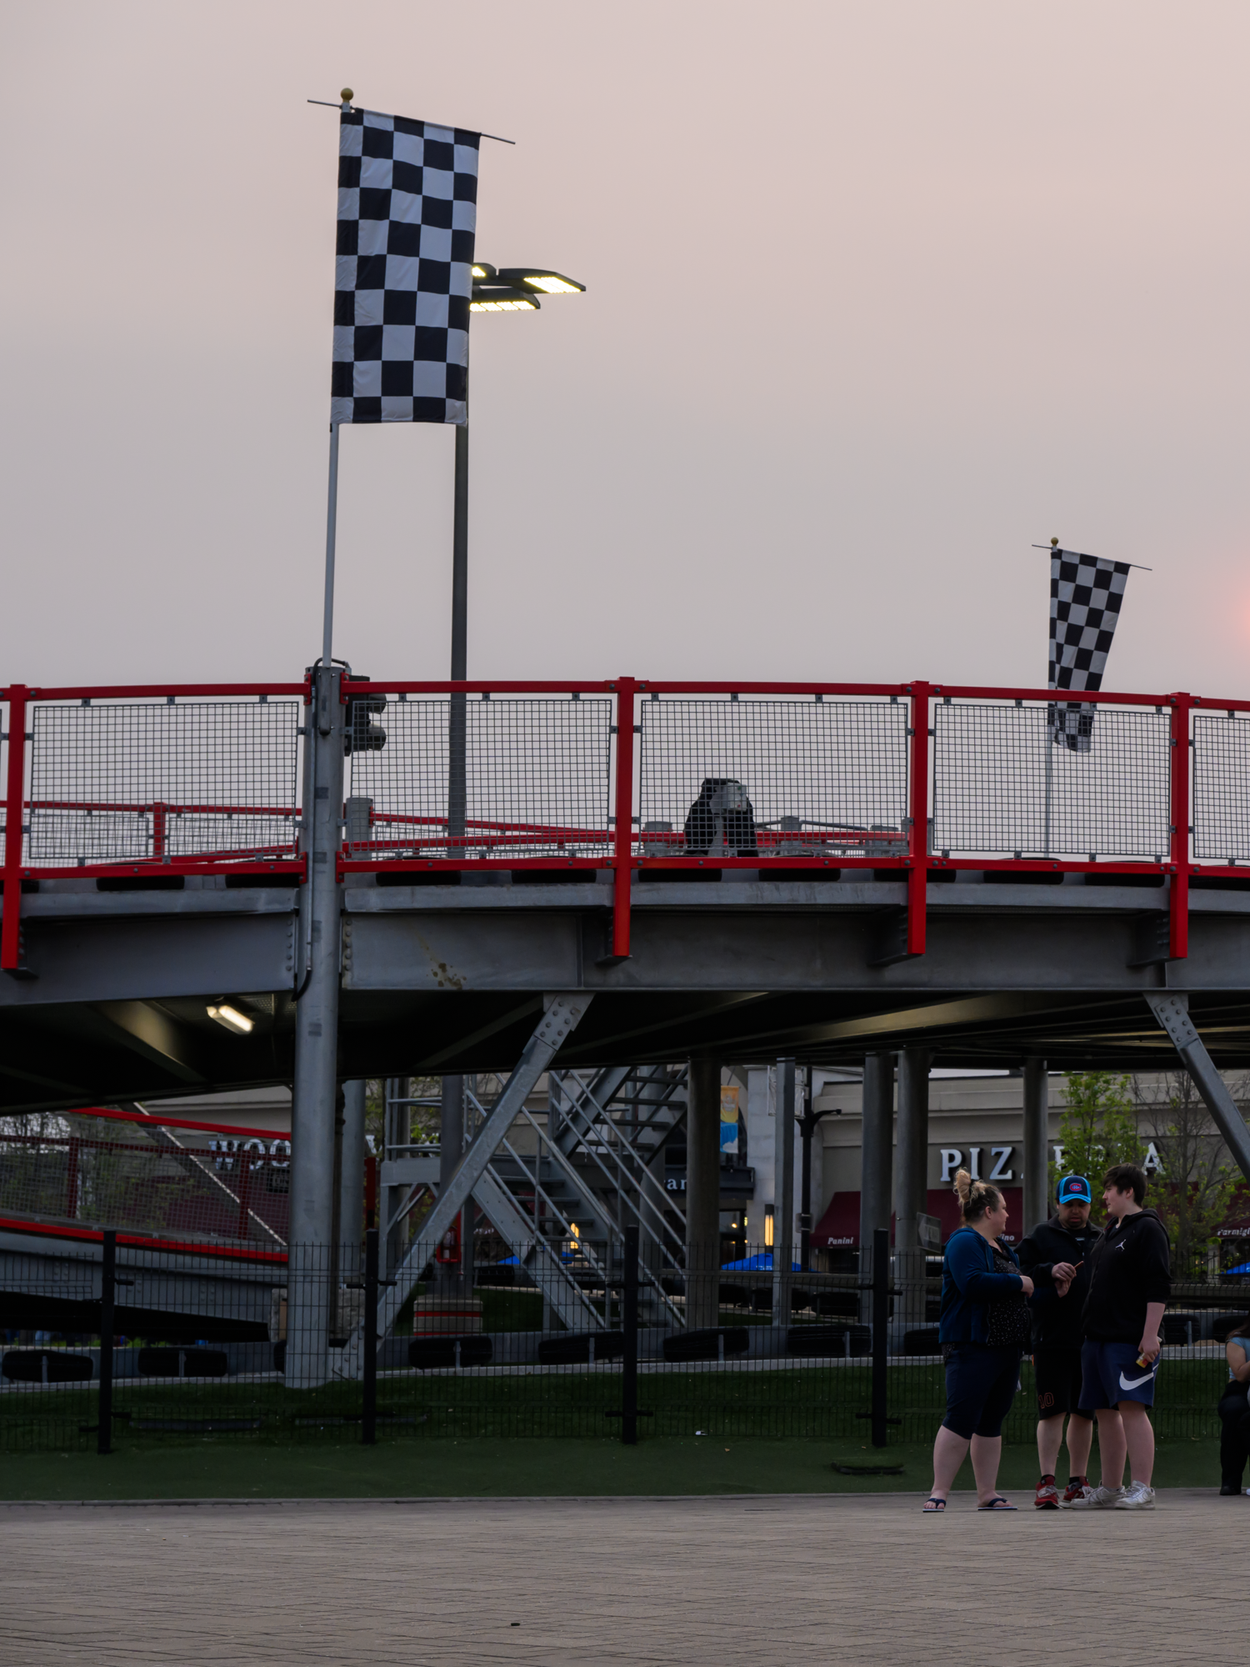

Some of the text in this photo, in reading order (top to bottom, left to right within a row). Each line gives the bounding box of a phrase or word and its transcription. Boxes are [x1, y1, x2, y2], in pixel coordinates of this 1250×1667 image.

[208, 1138, 291, 1170] WOO
[940, 1141, 1165, 1182] PIZEA
[827, 1236, 854, 1245] Panini
[1000, 1233, 1015, 1242] ino
